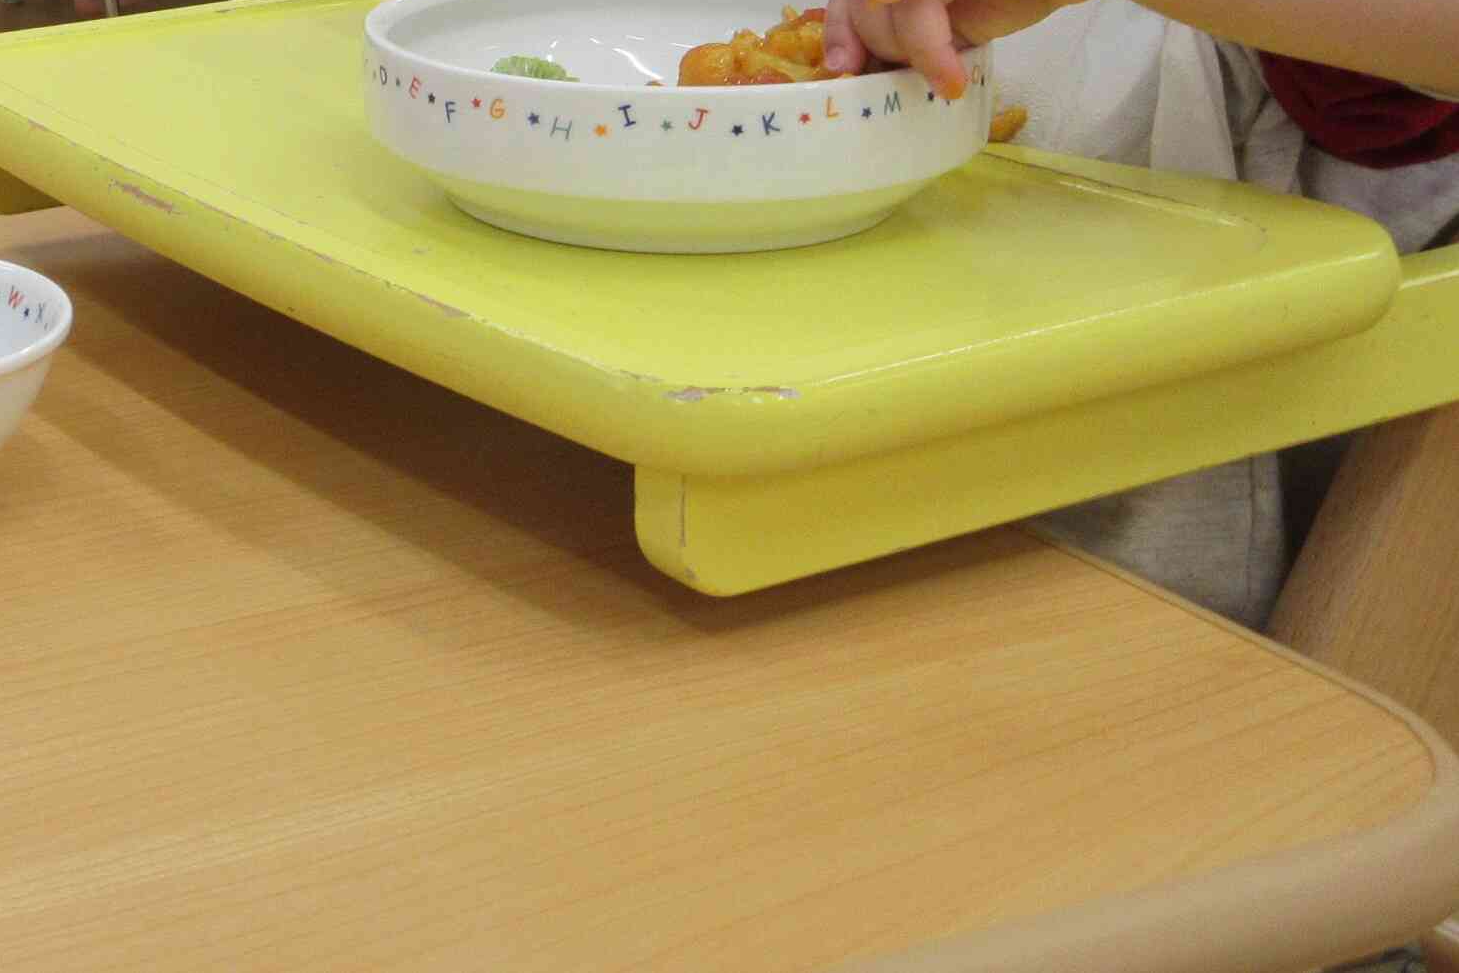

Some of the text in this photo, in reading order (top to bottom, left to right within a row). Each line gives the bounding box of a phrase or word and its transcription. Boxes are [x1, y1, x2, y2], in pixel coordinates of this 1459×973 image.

[379, 65, 388, 86] D
[409, 75, 423, 100] E
[444, 100, 456, 124] F
[489, 97, 508, 120] G
[550, 115, 572, 139] H
[617, 103, 637, 129] I
[688, 107, 710, 132] J
[760, 111, 781, 137] K
[825, 96, 840, 121] L
[883, 90, 902, 116] M
[7, 285, 26, 310] W
